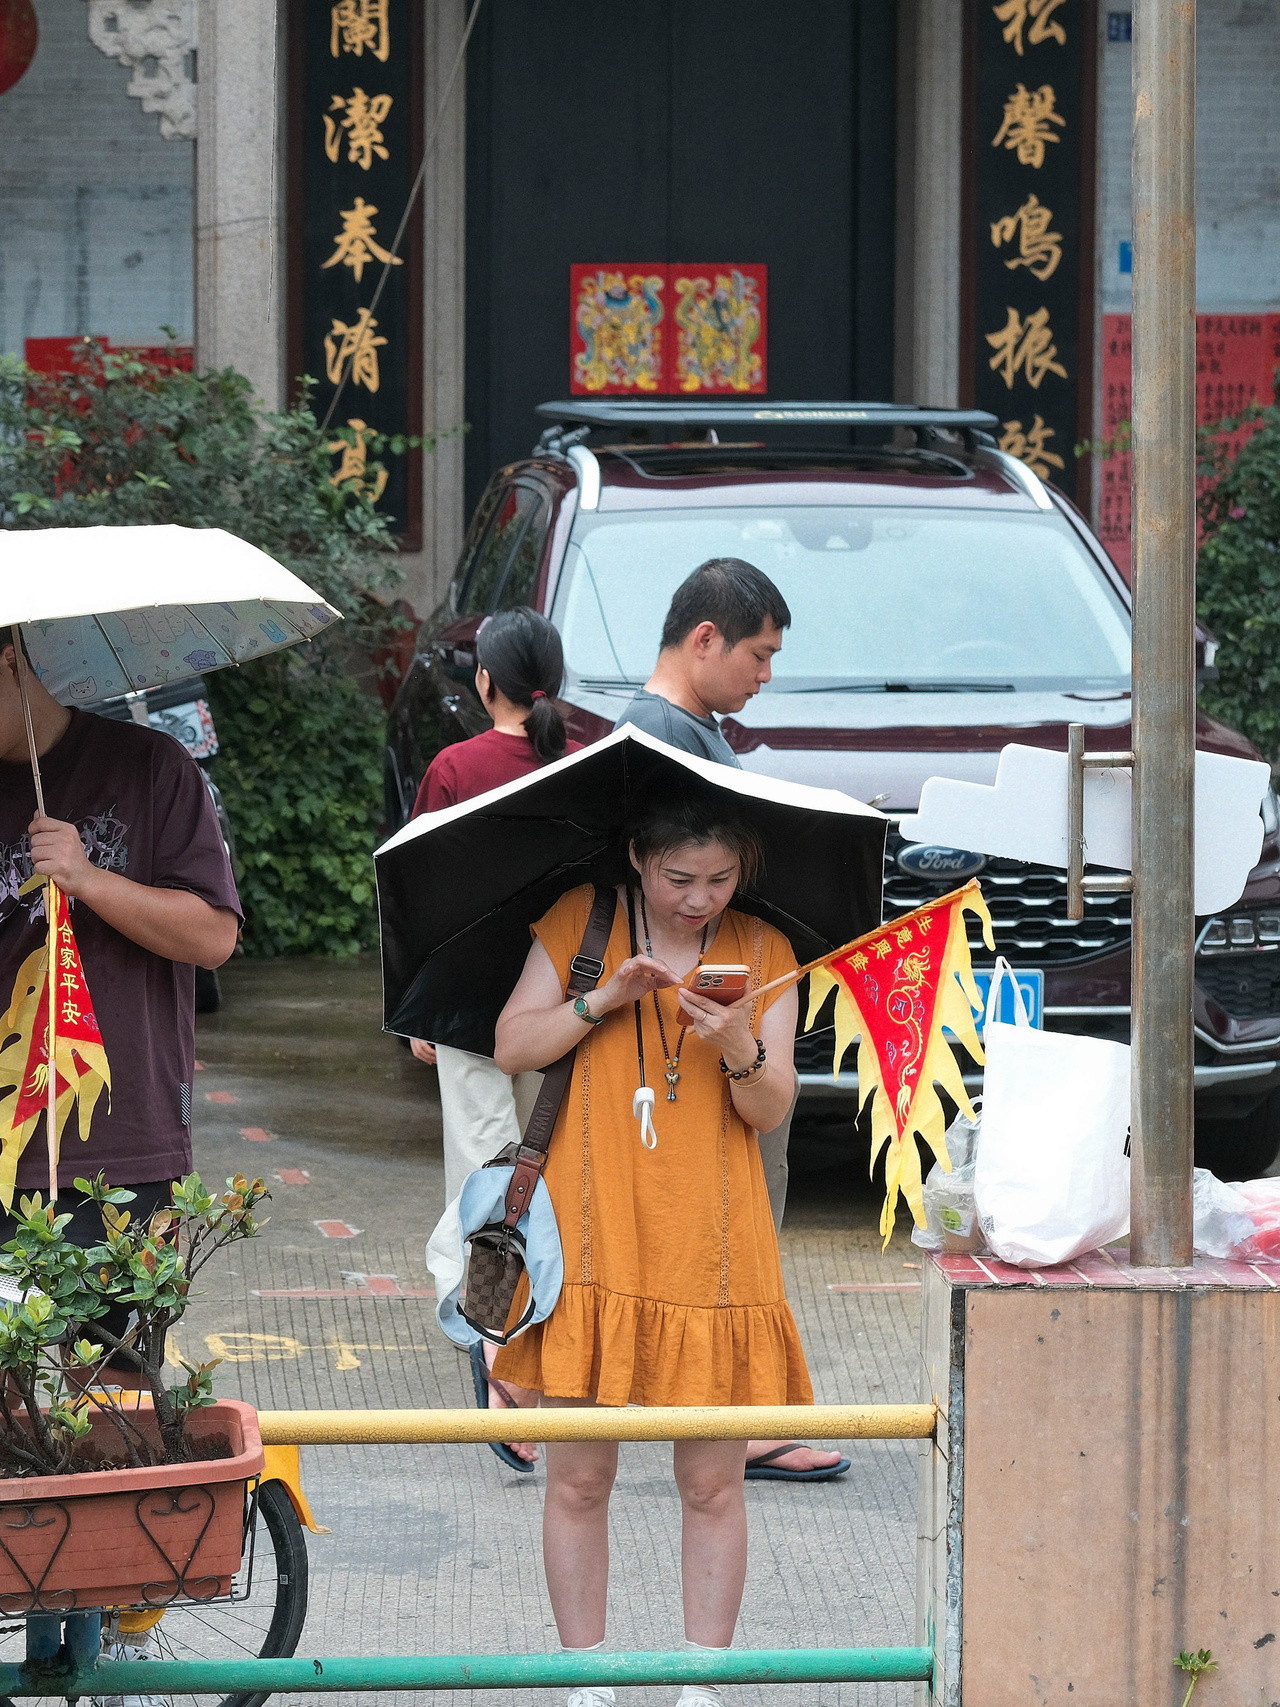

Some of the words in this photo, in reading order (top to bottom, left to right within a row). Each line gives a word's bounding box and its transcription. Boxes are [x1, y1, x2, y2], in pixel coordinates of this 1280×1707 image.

[919, 849, 966, 870] Ford
[57, 918, 82, 1026] 合家平安
